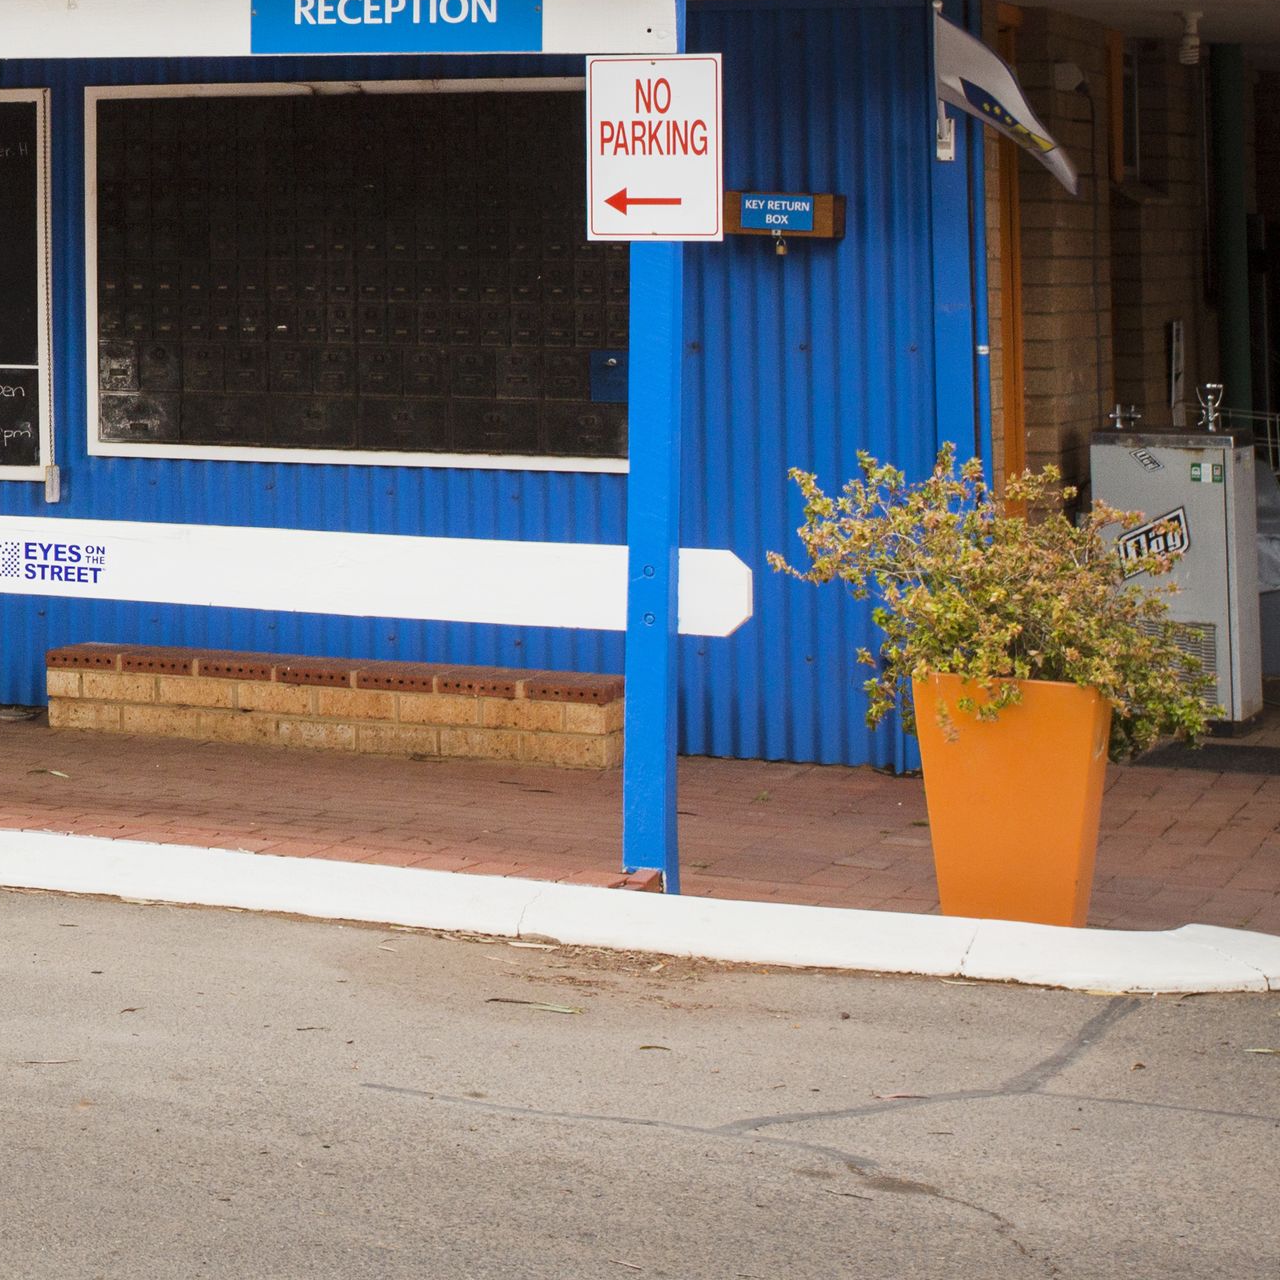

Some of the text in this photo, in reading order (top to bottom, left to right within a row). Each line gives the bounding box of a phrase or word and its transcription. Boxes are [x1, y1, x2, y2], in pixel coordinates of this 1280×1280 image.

[635, 77, 671, 114] NO
[600, 119, 708, 156] PARKING
[745, 199, 810, 211] KEY RETURN
[765, 214, 788, 225] BOX
[24, 542, 105, 563] EYES ON
[85, 556, 105, 565] THE
[25, 563, 102, 583] STREET
